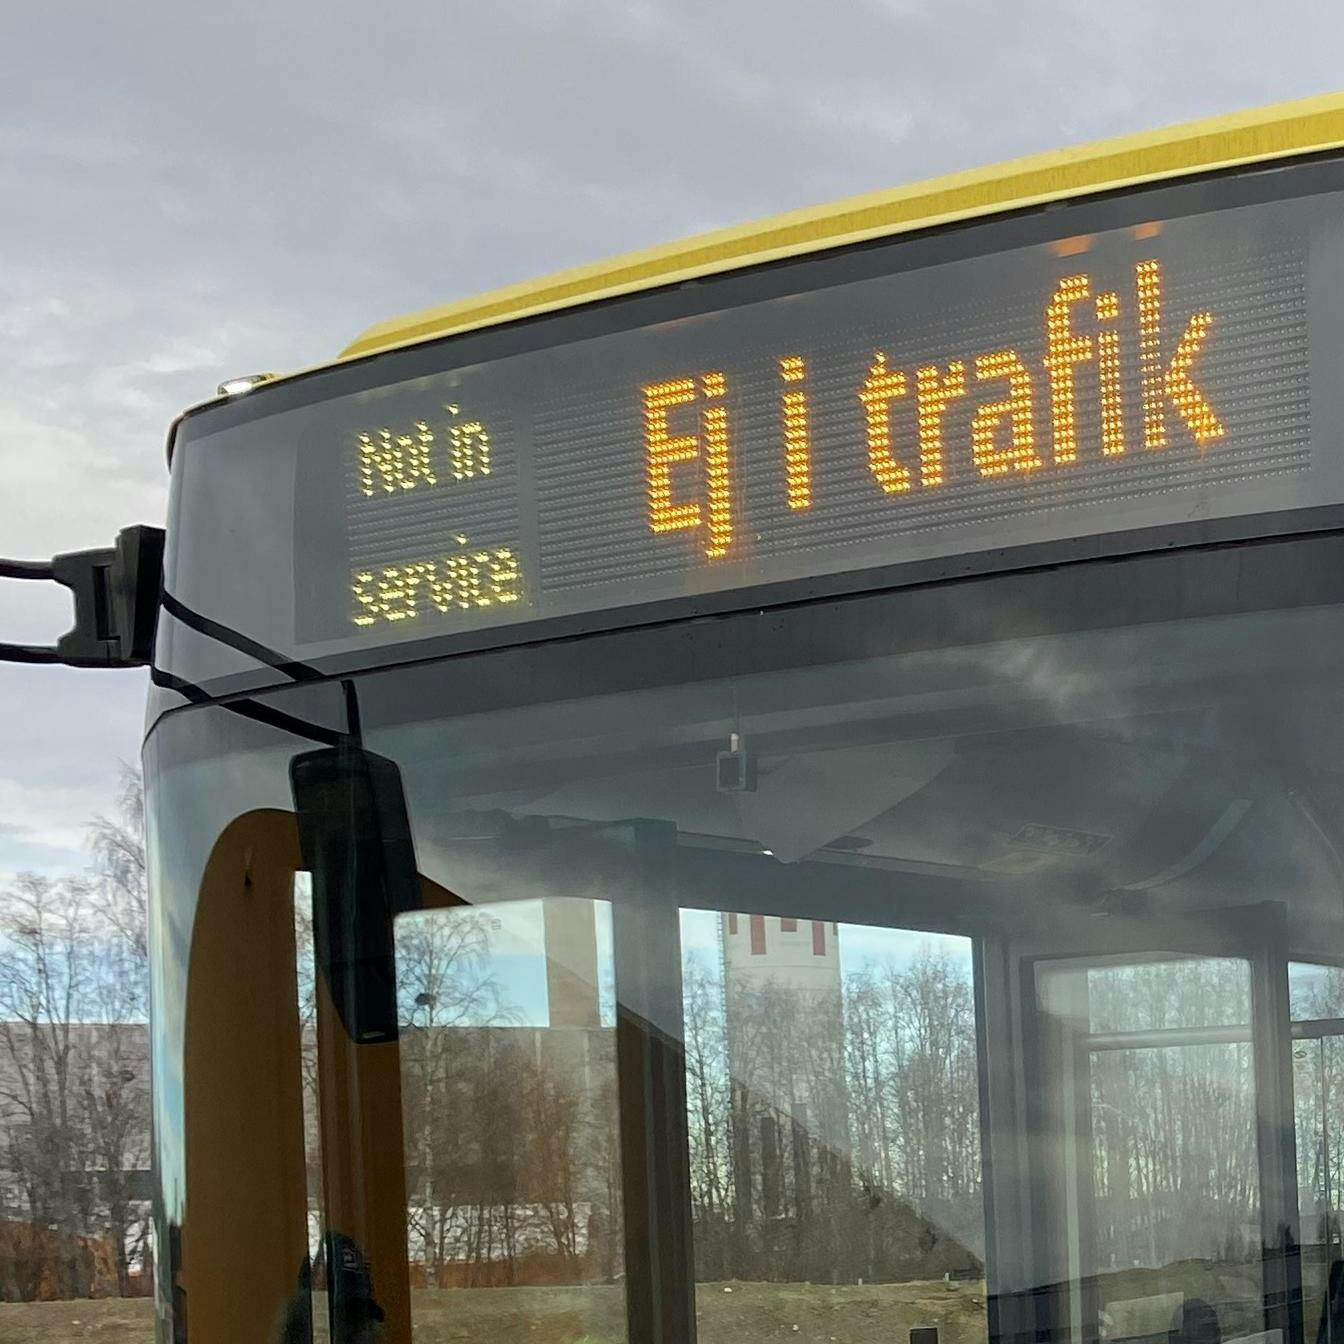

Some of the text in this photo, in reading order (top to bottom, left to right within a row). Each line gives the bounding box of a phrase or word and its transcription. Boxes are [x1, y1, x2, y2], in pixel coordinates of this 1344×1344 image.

[357, 403, 492, 497] Not in
[641, 256, 1226, 561] Ej i trafik
[351, 532, 525, 628] service
